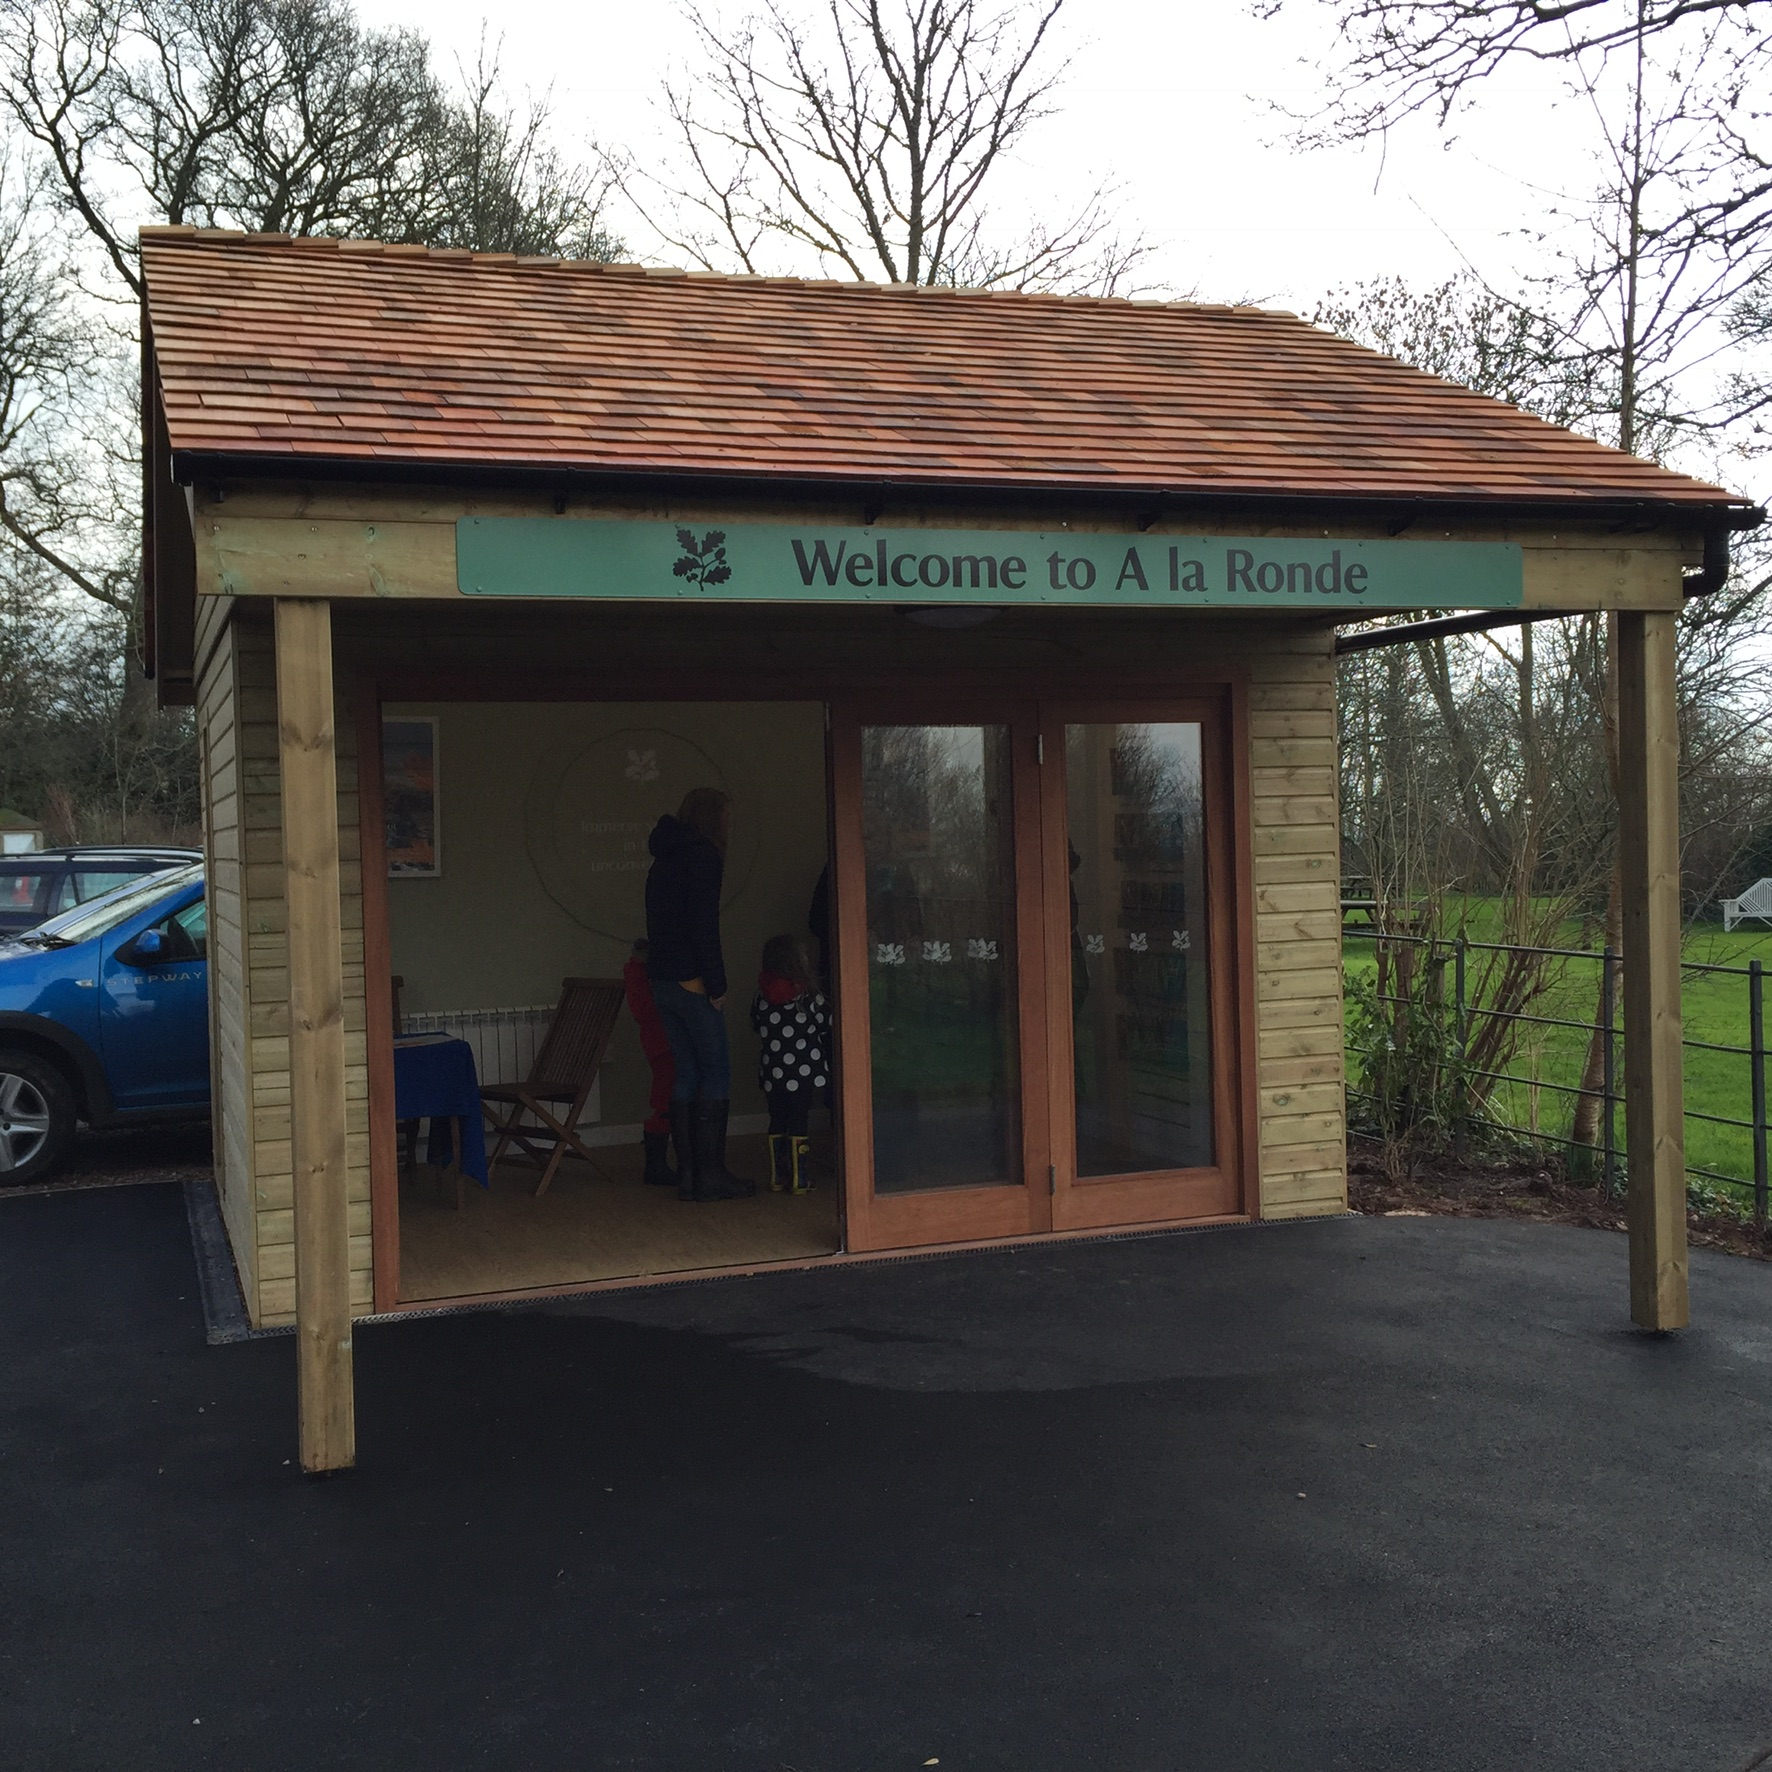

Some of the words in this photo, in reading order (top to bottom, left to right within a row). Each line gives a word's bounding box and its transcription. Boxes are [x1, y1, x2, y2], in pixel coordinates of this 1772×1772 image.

[790, 539, 1028, 590] Welcome
[1046, 550, 1097, 591] to
[1114, 546, 1150, 591] A
[1168, 546, 1209, 593] la
[1226, 548, 1369, 595] Ronde
[106, 971, 203, 987] STEPWAY
